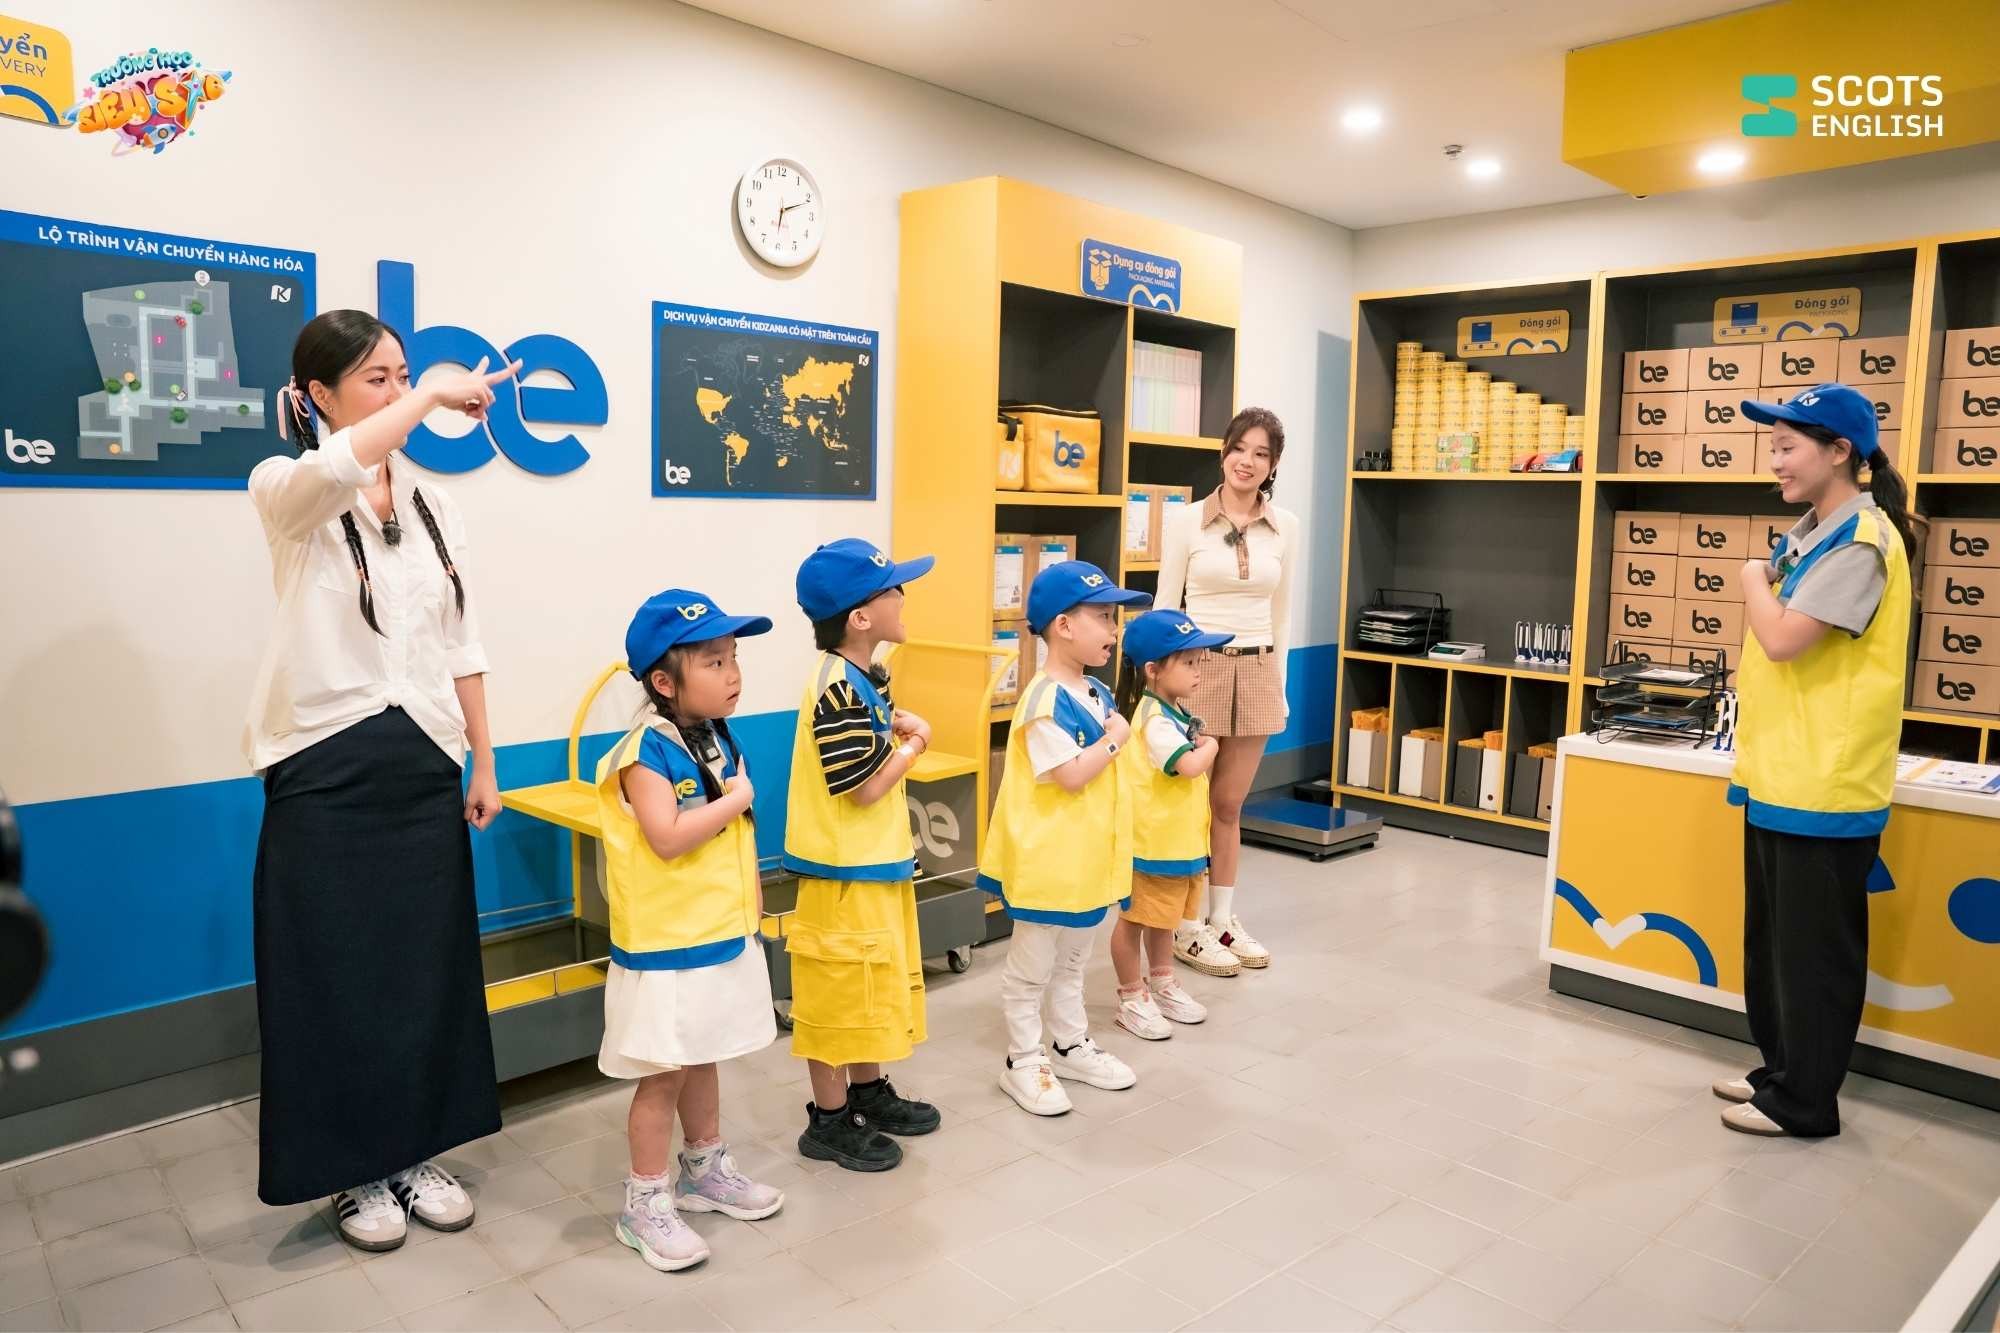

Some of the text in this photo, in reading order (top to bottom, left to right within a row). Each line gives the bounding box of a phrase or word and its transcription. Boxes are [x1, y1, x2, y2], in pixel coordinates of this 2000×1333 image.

[38, 225, 304, 272] LỘ TRÌNH VẬN CHUYỂN HÀNG HÓA
[1795, 296, 1849, 309] Đóng gói
[664, 310, 684, 322] DỊCH
[686, 313, 697, 324] VỤ
[699, 313, 717, 326] VẬN
[752, 322, 788, 334] KIDZANIA
[1520, 318, 1544, 328] Đóng
[1781, 352, 1815, 376] be
[1860, 349, 1896, 375] be
[1967, 339, 2000, 367] be
[376, 259, 608, 476] be
[1640, 360, 1669, 382] be
[1708, 357, 1739, 381] be
[1638, 402, 1667, 426] be
[1705, 400, 1735, 424] be
[1963, 390, 2000, 417] be
[5, 429, 56, 464] be
[1054, 430, 1084, 468] be
[1635, 444, 1663, 468] be
[1702, 443, 1732, 468] be
[1957, 439, 1998, 467] be
[665, 459, 691, 485] be
[1629, 521, 1657, 545] be
[1697, 524, 1727, 549] be
[1950, 529, 1989, 557] be
[1081, 574, 1104, 587] be
[1628, 563, 1656, 586] be
[1695, 568, 1724, 592] be
[1945, 577, 1985, 606] be
[676, 603, 708, 621] be
[1624, 604, 1652, 628] be
[1692, 610, 1722, 634] be
[1175, 622, 1194, 634] be
[1943, 626, 1982, 654] be
[1937, 673, 1976, 701] be
